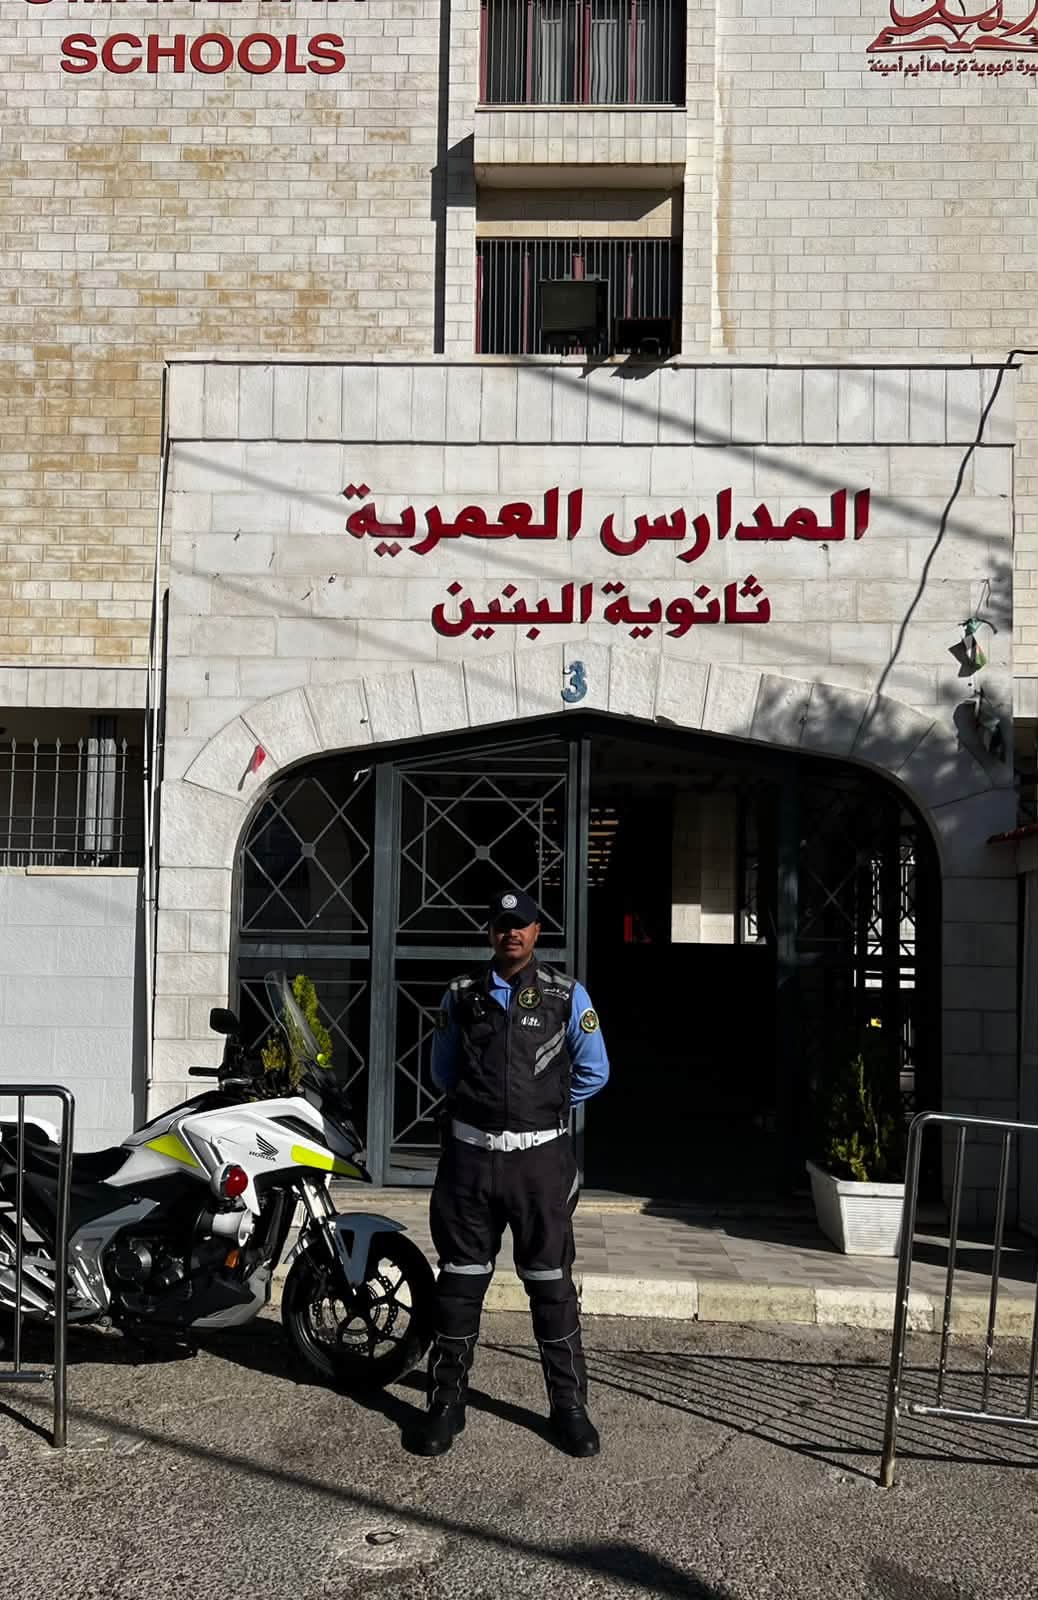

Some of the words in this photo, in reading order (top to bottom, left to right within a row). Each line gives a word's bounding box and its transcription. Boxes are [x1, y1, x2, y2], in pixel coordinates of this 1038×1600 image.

[60, 33, 345, 74] SCHOOLS
[867, 55, 903, 76] أمينة
[926, 58, 968, 75] ترعاها
[968, 59, 1013, 76] تربوية
[344, 482, 583, 556] العمرية
[600, 487, 870, 563] المدارس
[431, 581, 594, 640] البنين
[602, 575, 770, 638] ثانوية
[561, 661, 589, 703] 3
[249, 1151, 277, 1162] HONDA
